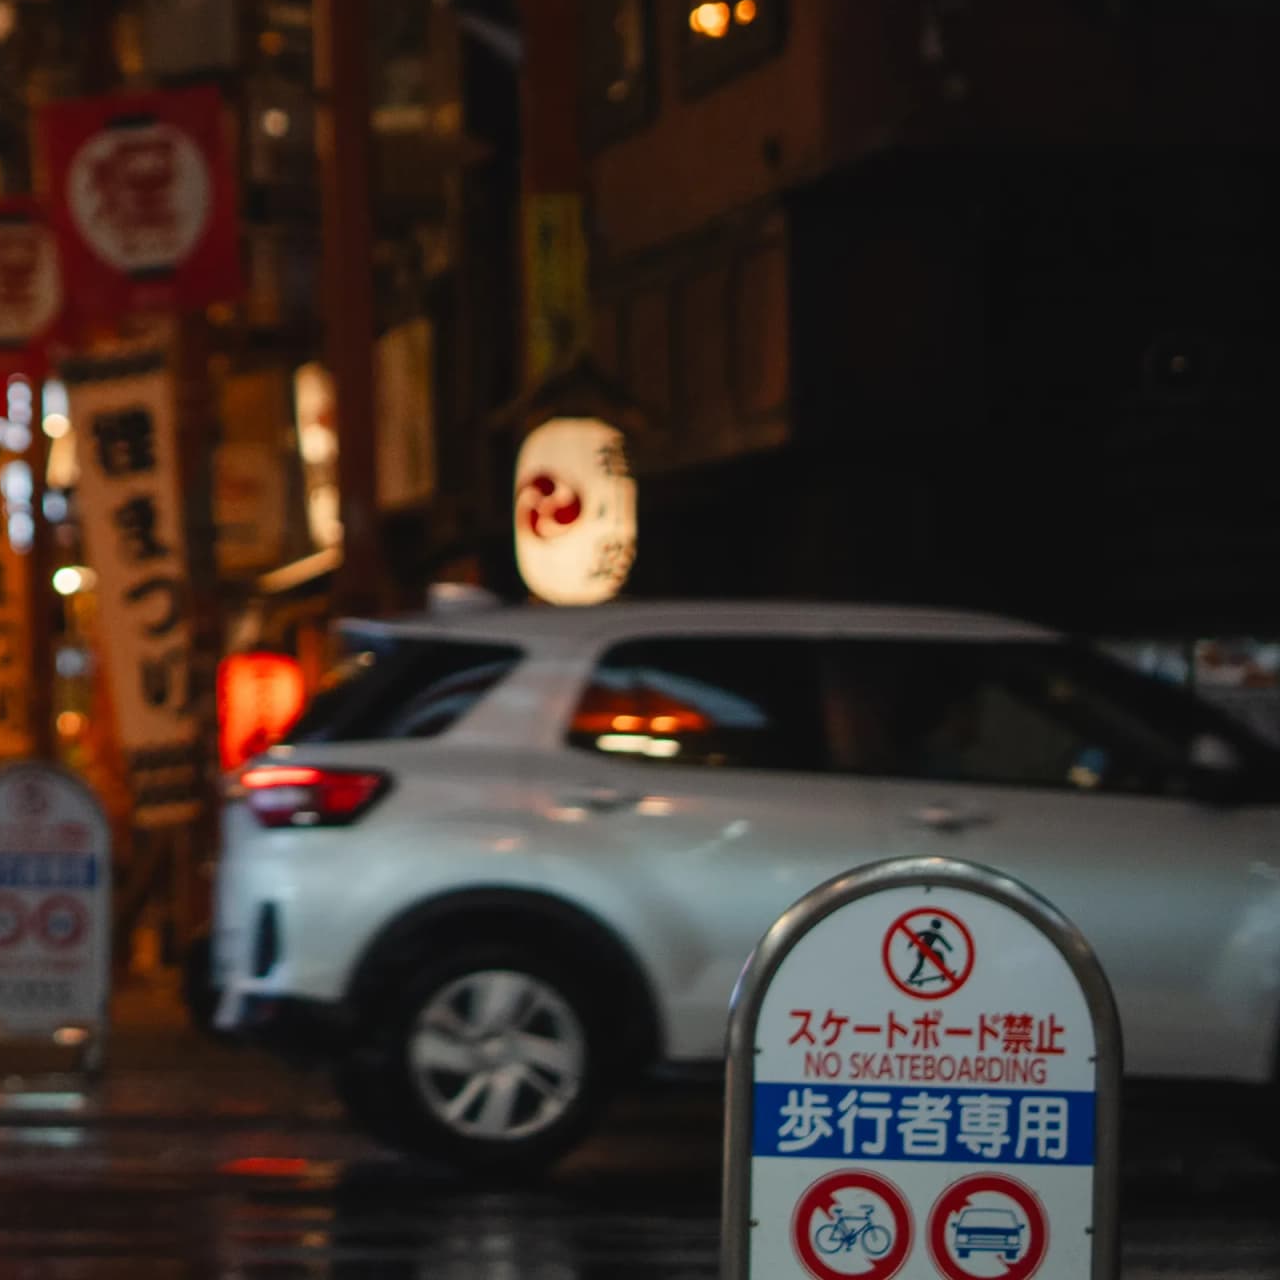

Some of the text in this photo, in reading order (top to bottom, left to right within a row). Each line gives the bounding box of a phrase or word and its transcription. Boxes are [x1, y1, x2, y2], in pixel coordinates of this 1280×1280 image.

[787, 1008, 1066, 1056] スケートボード禁止
[804, 1051, 1048, 1085] NO SKATEBOARDING
[777, 1087, 1070, 1160] 歩行者専用
